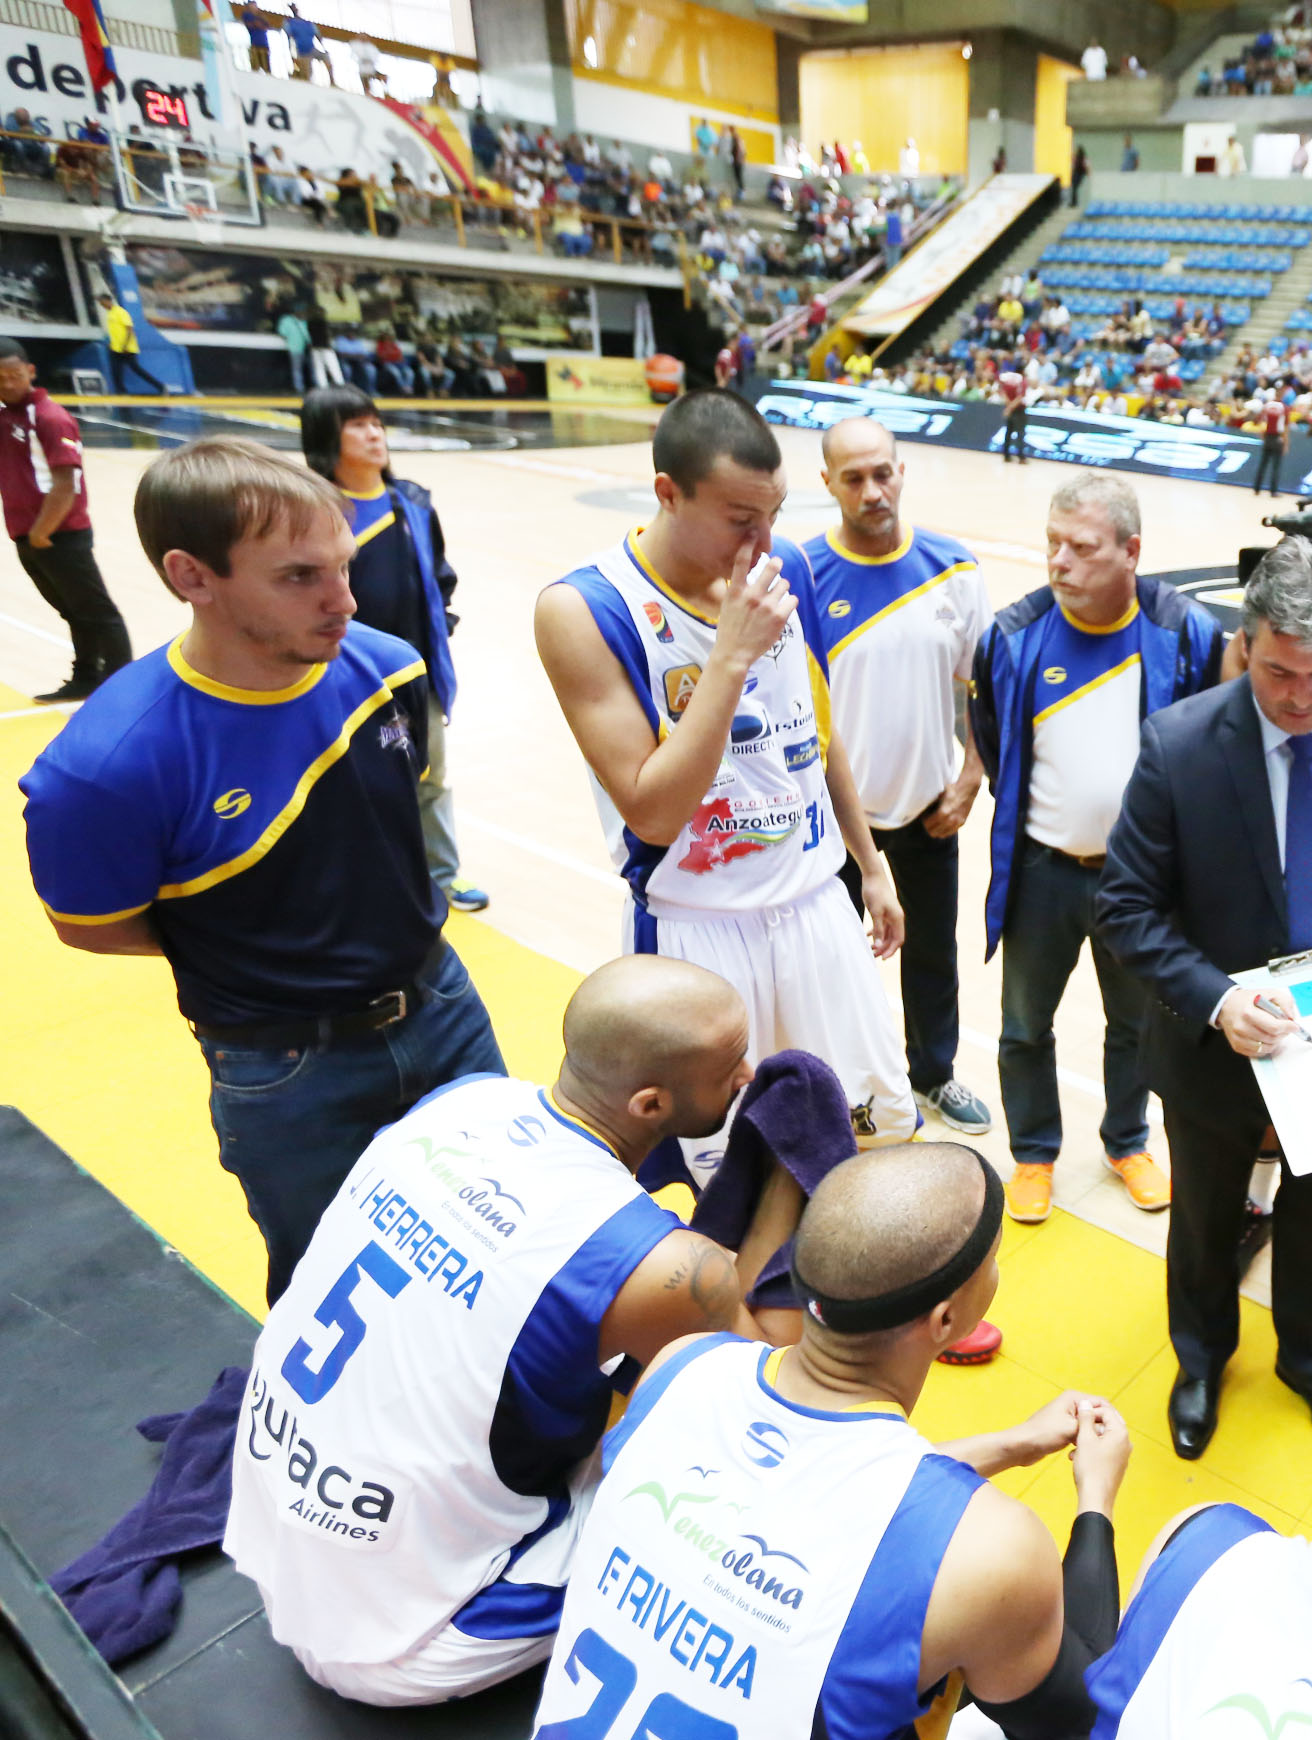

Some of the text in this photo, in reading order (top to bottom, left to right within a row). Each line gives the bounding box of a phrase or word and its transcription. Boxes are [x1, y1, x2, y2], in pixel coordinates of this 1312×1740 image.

[6, 44, 292, 131] deportva
[145, 90, 189, 127] 24
[281, 1239, 413, 1405] 5
[288, 1497, 380, 1543] Airlines
[620, 1480, 805, 1611] Venezolana
[703, 1573, 792, 1634] En todos los sentidos
